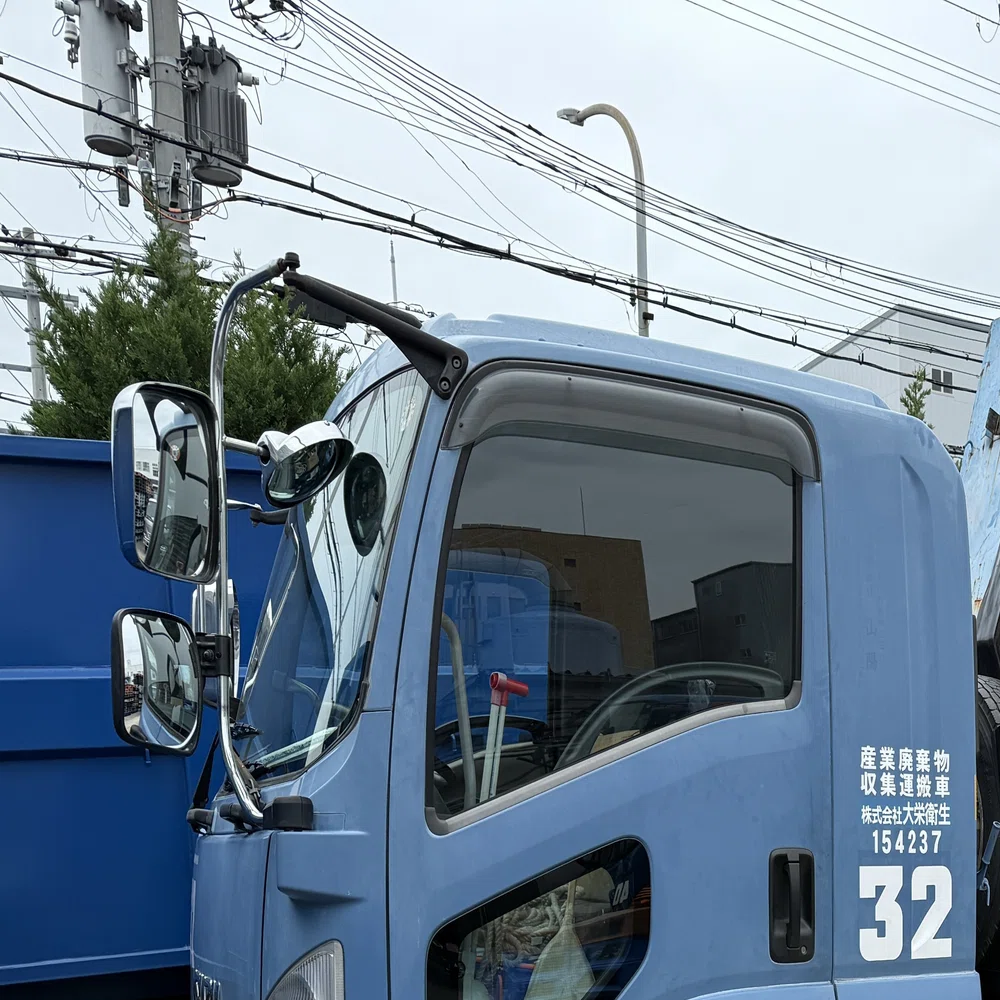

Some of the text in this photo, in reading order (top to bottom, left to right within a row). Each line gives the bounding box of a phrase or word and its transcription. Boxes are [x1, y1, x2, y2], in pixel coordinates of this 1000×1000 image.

[860, 745, 951, 773] 産業廃棄物
[860, 772, 951, 798] 収集運搬車
[861, 802, 951, 826] 株式会社大栄衛生
[872, 829, 942, 854] 154237
[859, 865, 952, 962] 32
